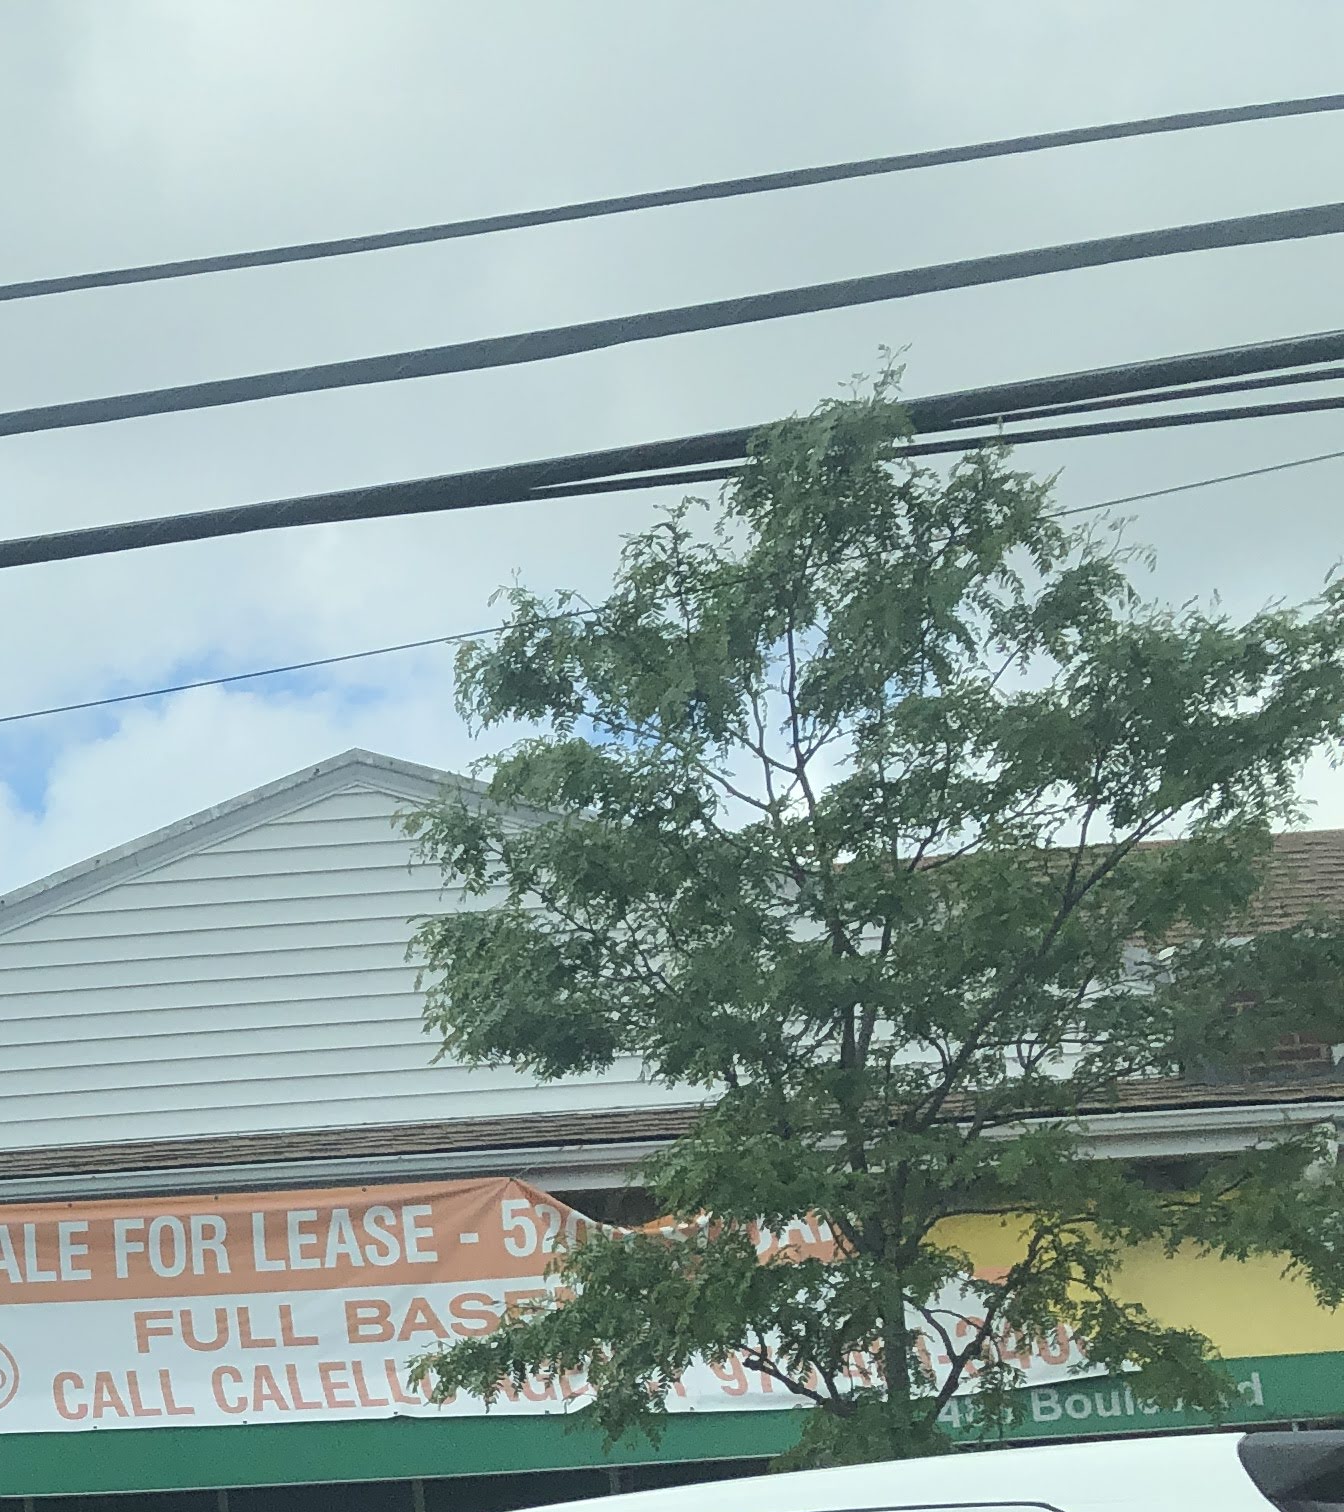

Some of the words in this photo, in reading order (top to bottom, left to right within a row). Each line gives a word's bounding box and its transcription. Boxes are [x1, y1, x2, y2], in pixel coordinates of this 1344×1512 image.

[113, 1211, 231, 1278] FOR
[252, 1205, 438, 1272] LEASE
[134, 1304, 319, 1353] FULL
[53, 1368, 195, 1420] CALL
